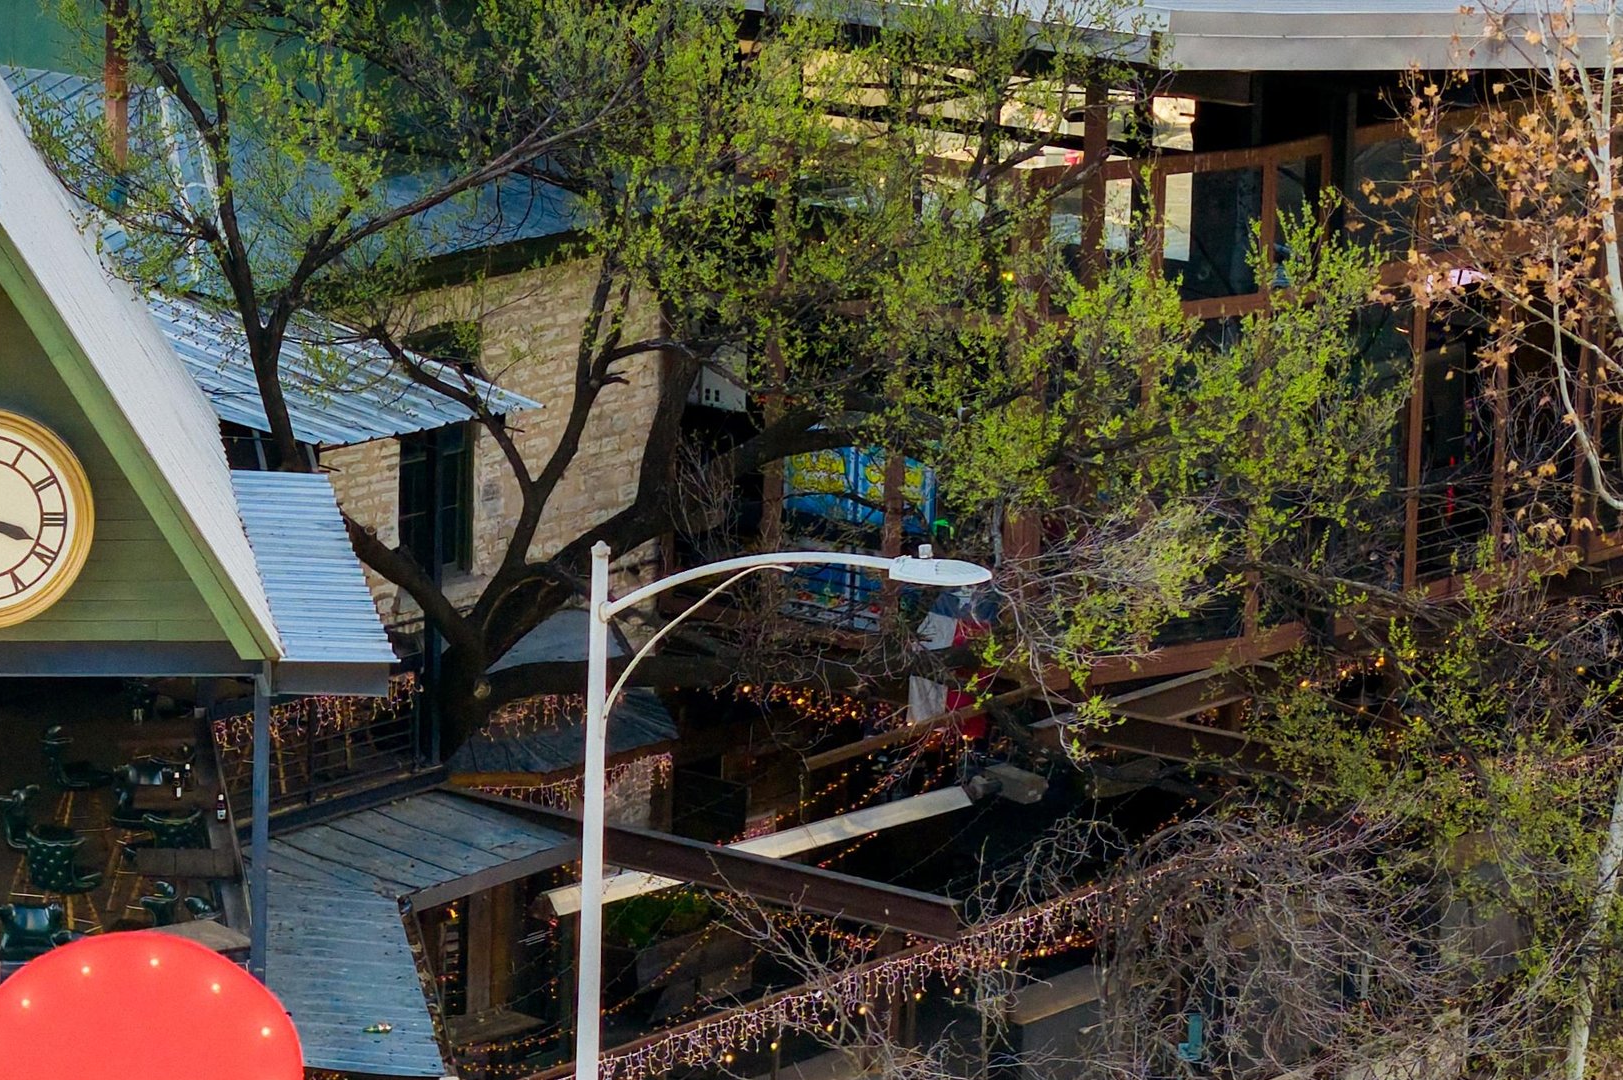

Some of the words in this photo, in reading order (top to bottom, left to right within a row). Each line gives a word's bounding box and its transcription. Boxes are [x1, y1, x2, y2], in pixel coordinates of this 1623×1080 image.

[11, 447, 27, 468] I
[32, 472, 58, 492] II
[41, 511, 66, 526] III
[10, 570, 27, 594] V
